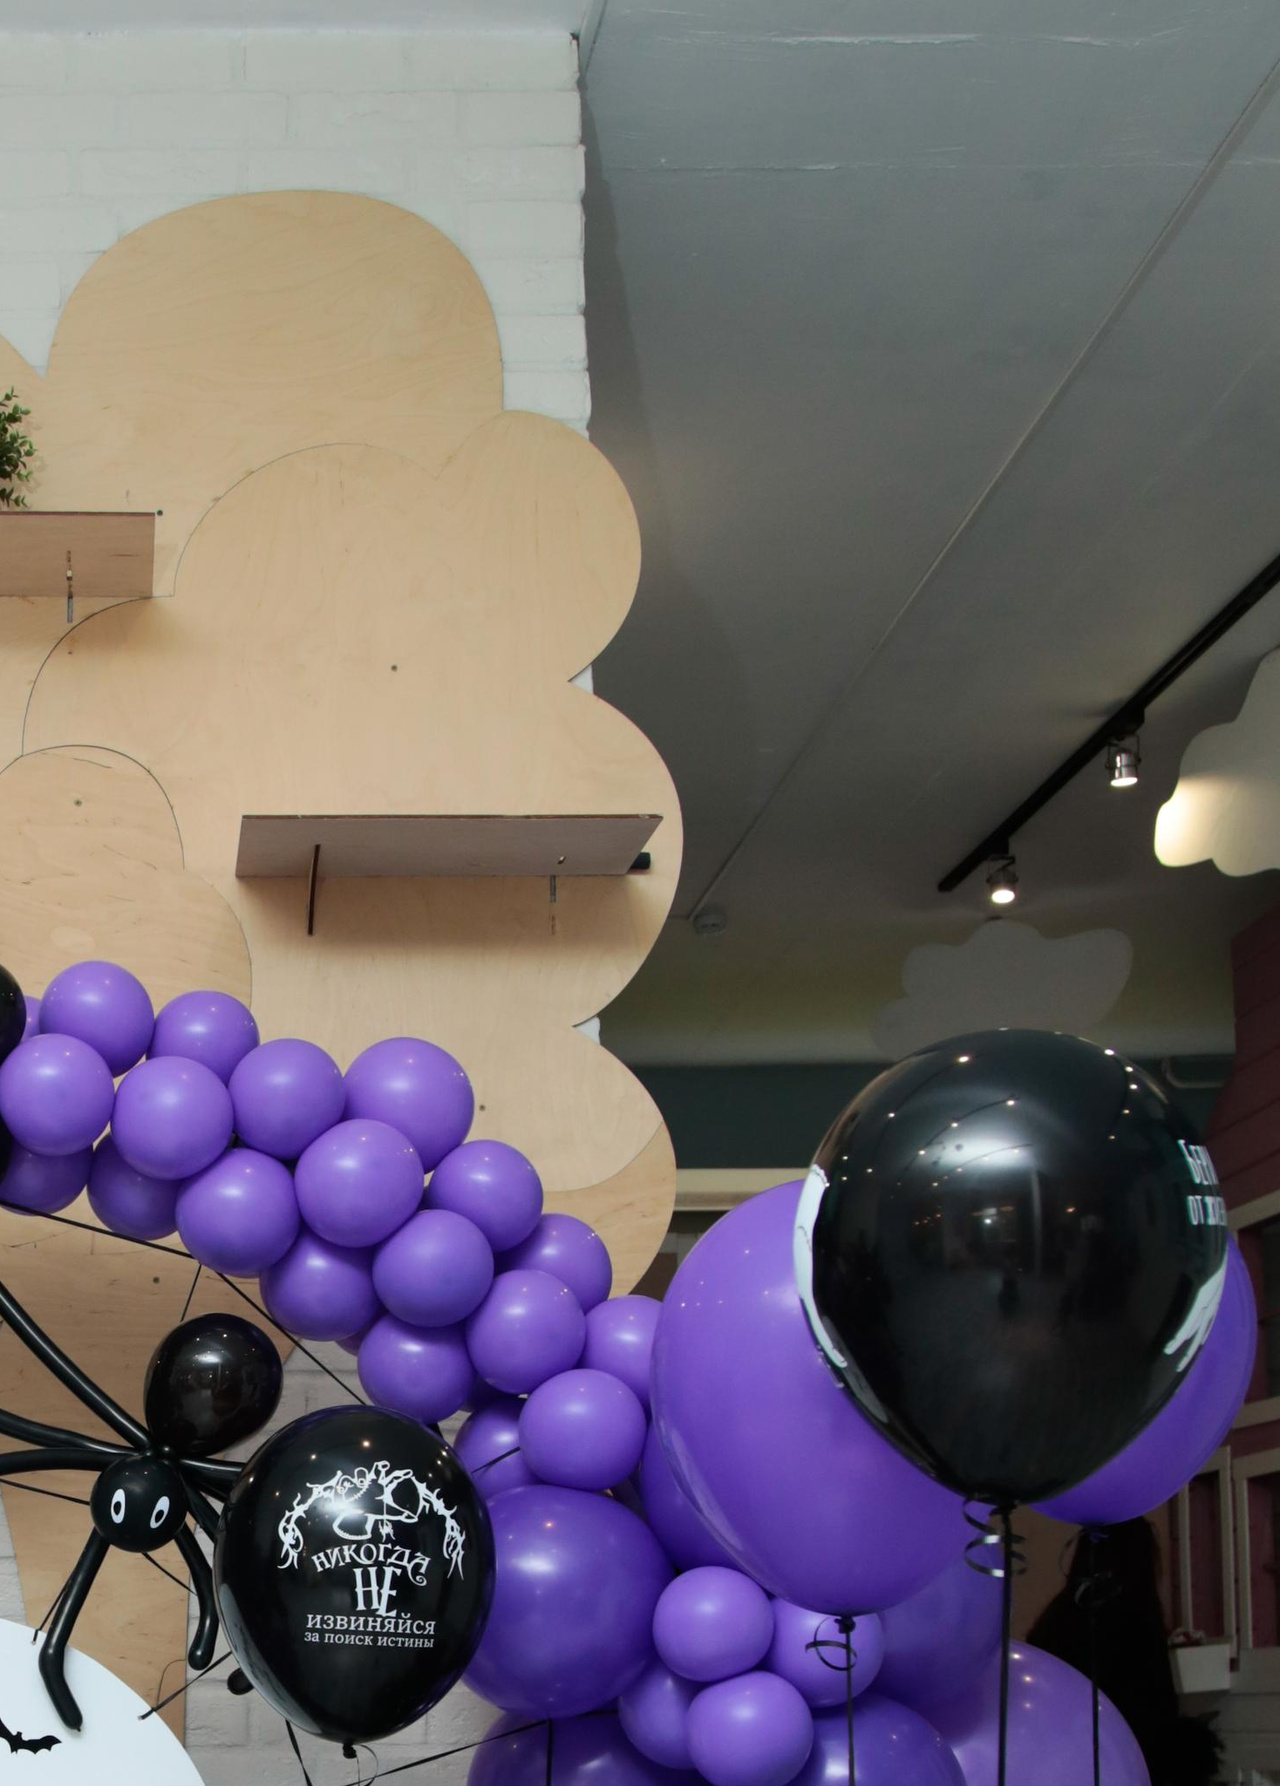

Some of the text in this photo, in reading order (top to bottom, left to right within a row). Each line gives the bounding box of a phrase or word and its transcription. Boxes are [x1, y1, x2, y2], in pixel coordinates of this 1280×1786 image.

[311, 1543, 431, 1587] НИКОГДА
[353, 1566, 402, 1618] НЕ
[324, 1633, 374, 1646] поиск
[377, 1636, 434, 1648] истины
